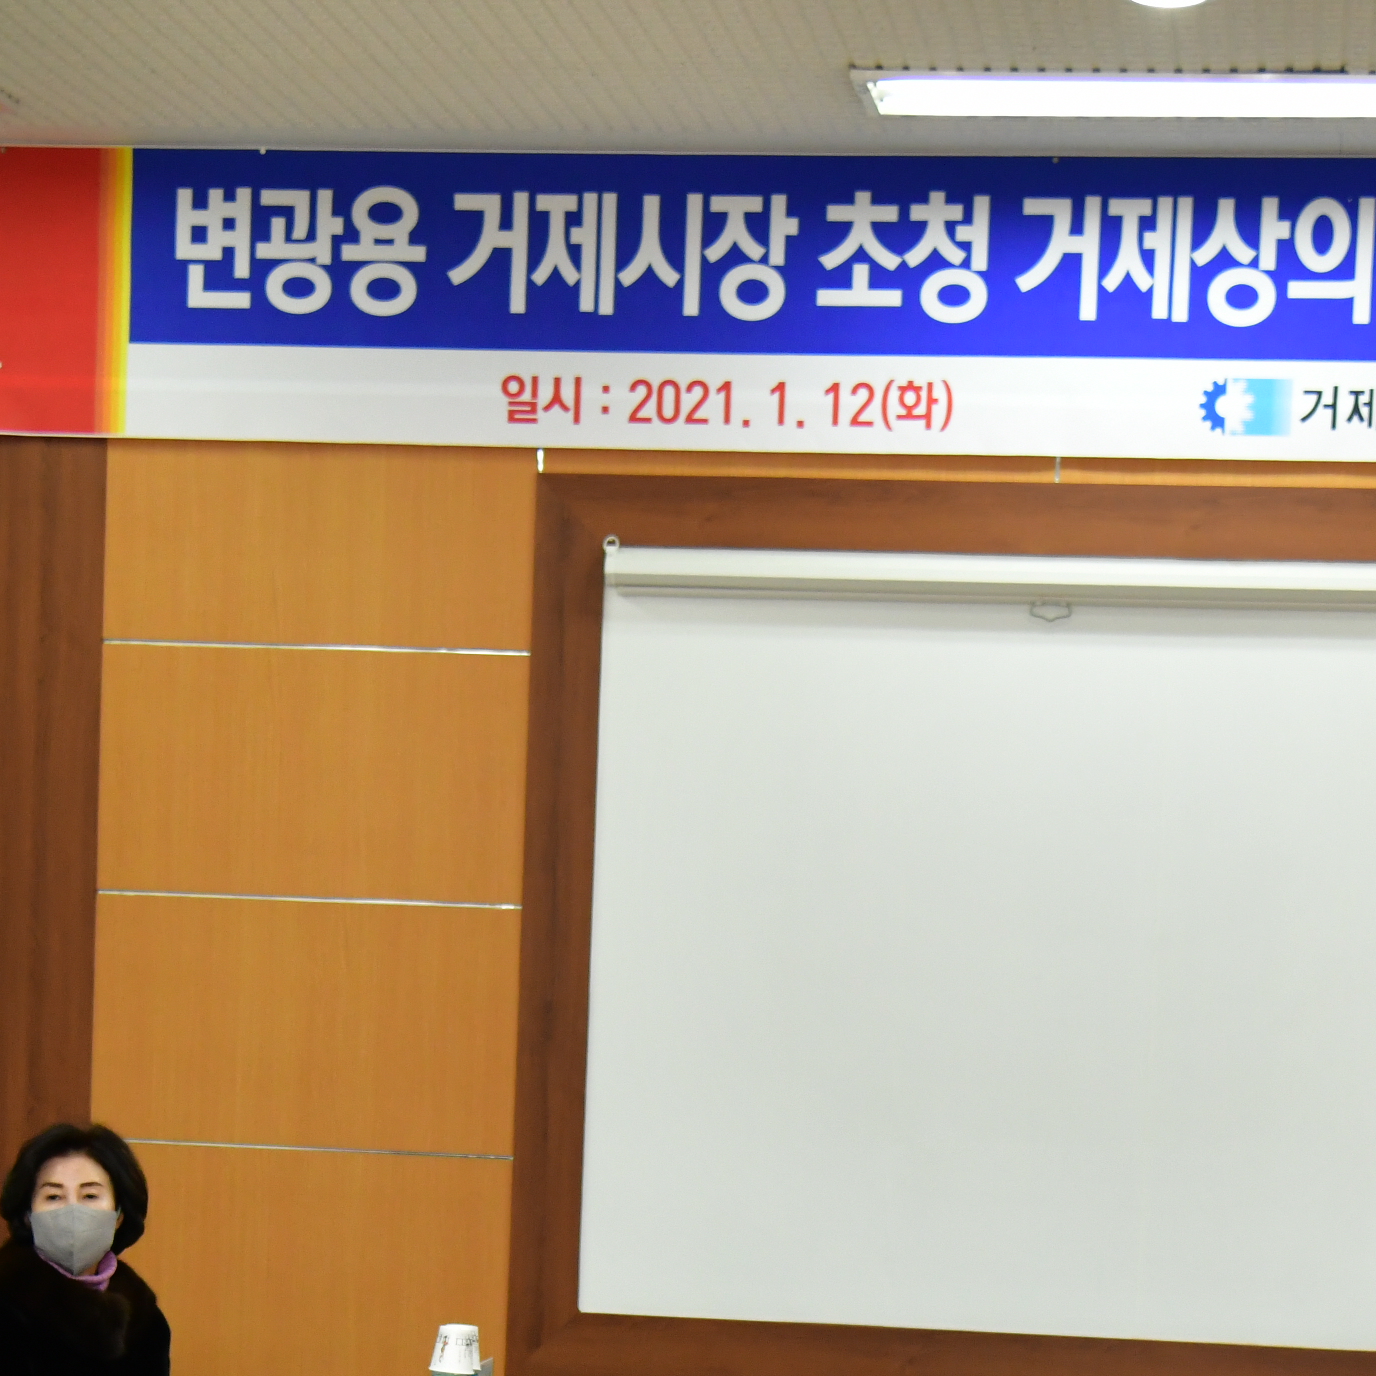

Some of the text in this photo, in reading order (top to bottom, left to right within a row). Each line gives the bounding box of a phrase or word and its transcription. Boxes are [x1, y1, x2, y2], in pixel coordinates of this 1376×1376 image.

[174, 187, 426, 318] 변광용
[448, 192, 799, 322] 거제시장
[816, 192, 991, 324] 초청
[1015, 196, 1376, 328] 거제상의
[501, 373, 955, 431] 일시 : 2021. 1. 12(화)
